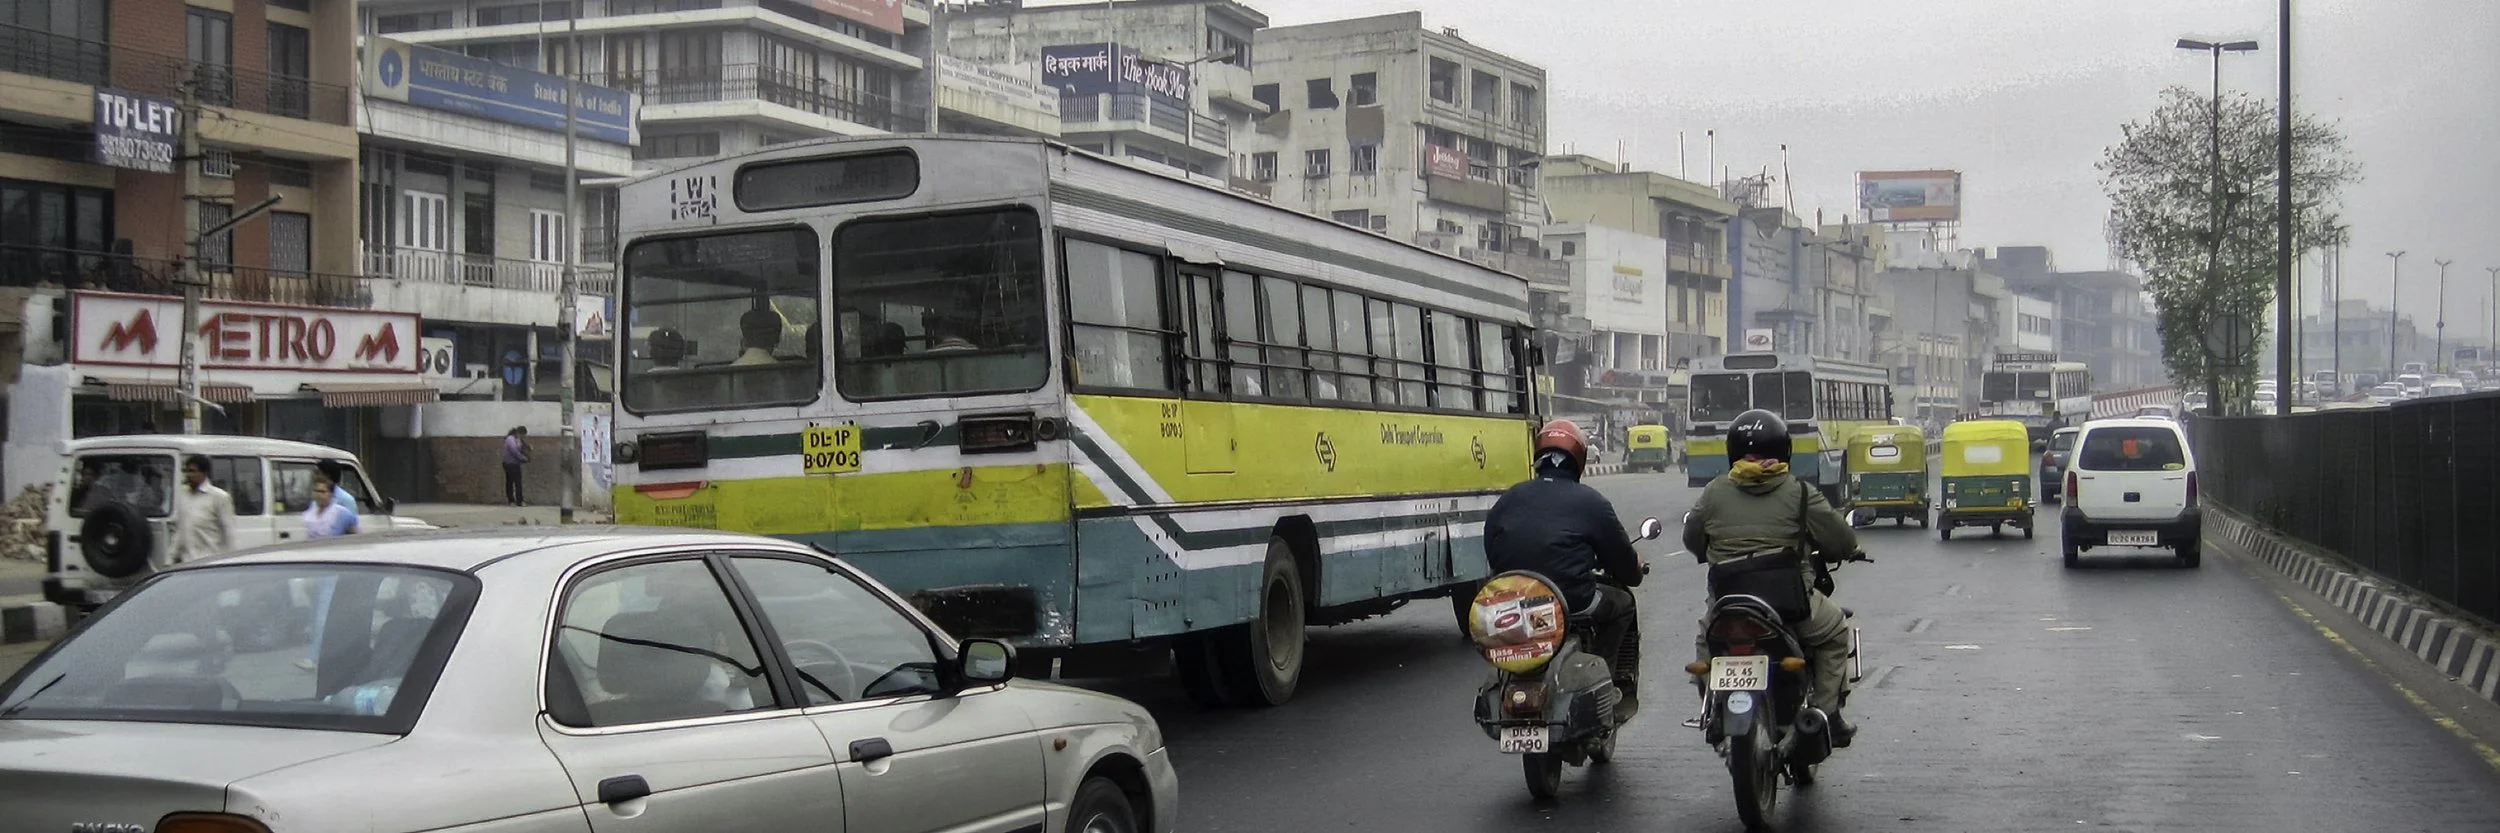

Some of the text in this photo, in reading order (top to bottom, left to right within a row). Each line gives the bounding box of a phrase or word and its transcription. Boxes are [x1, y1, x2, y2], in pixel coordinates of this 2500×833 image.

[1123, 54, 1142, 84] The
[1144, 64, 1169, 97] Book
[98, 92, 175, 135] TO-LET
[534, 82, 559, 103] State
[586, 95, 597, 112] of
[599, 97, 622, 117] India
[686, 176, 703, 199] W
[1492, 651, 1532, 663] Terminal
